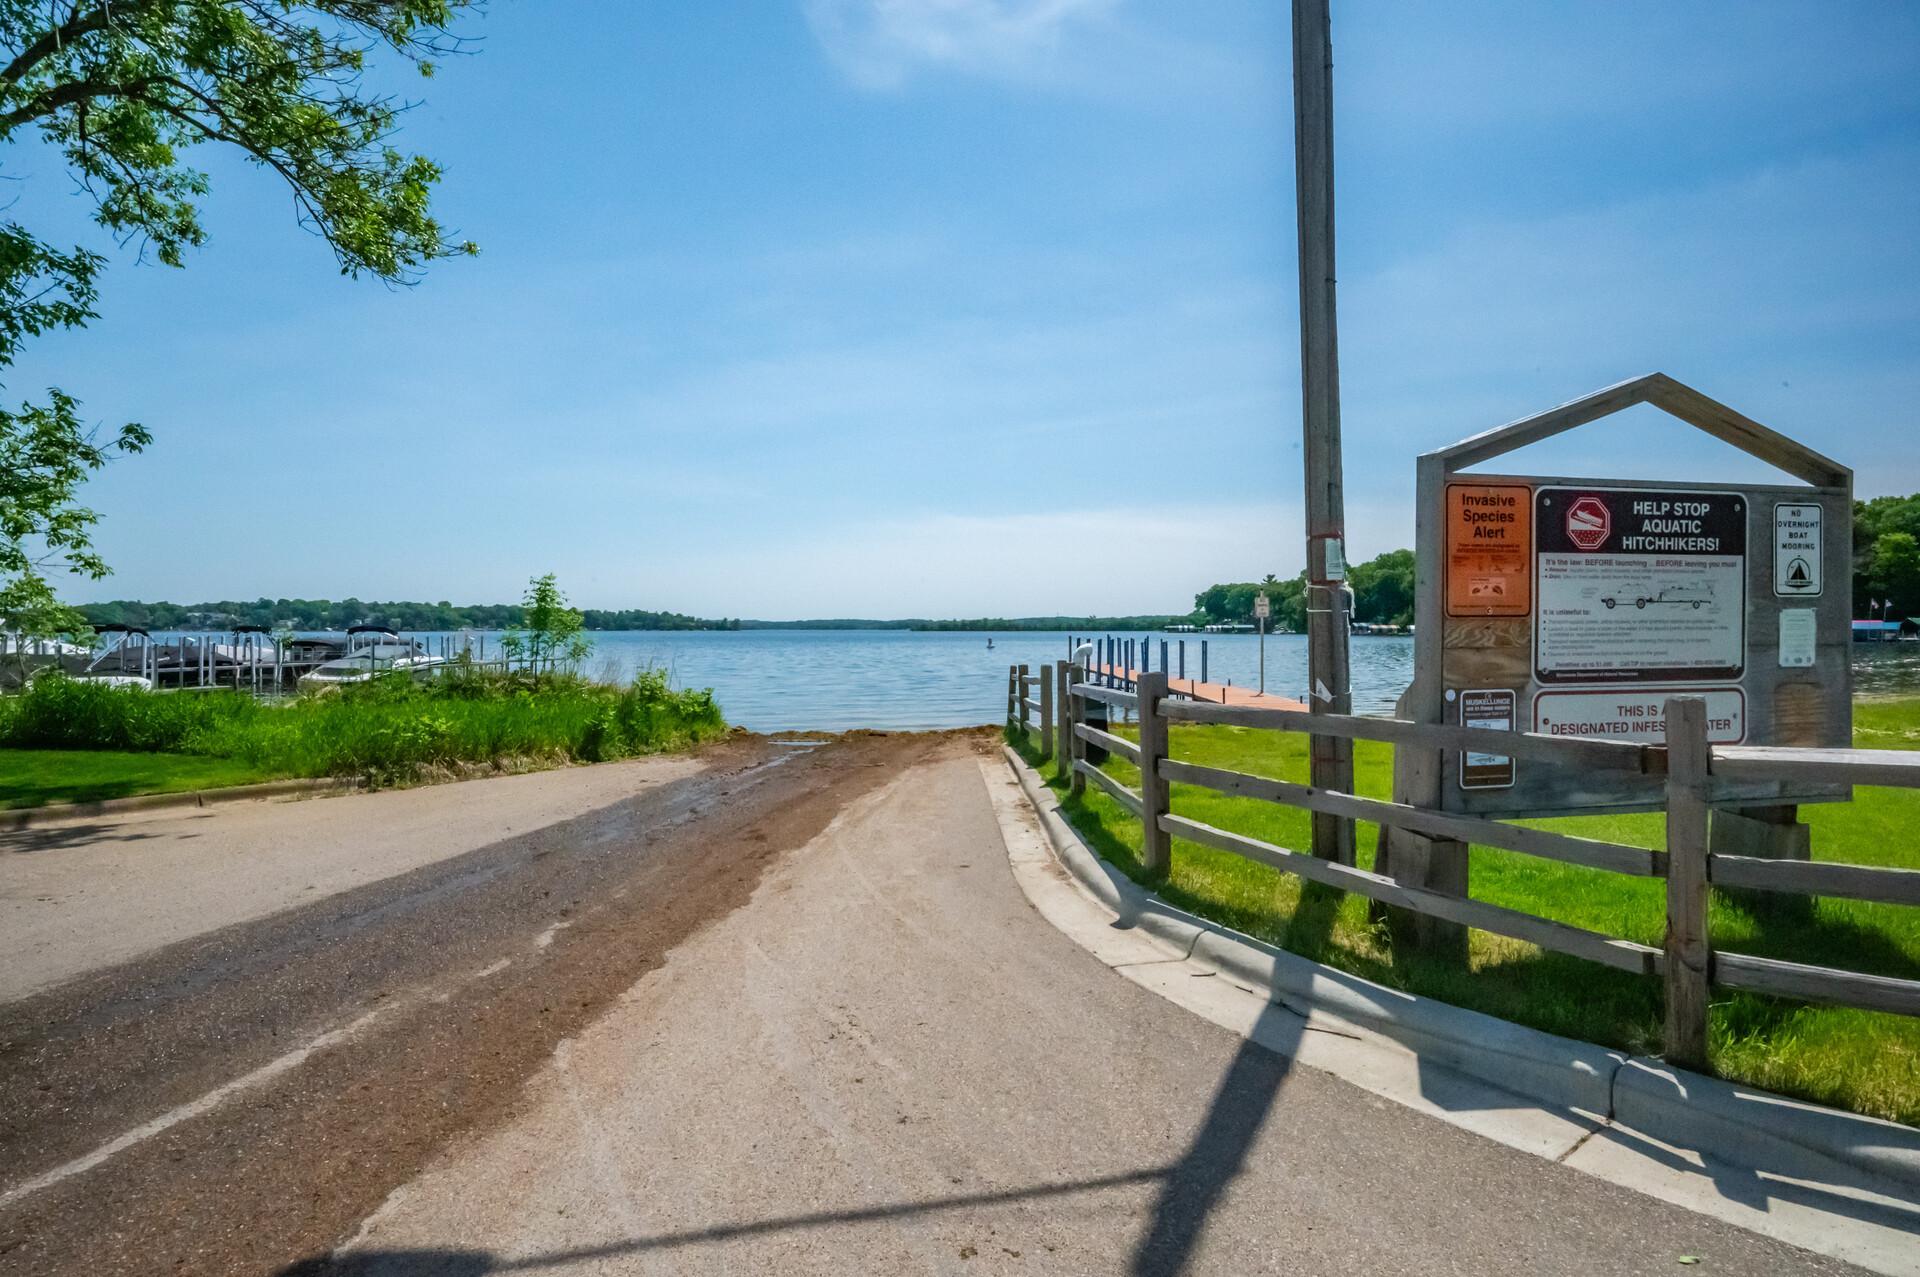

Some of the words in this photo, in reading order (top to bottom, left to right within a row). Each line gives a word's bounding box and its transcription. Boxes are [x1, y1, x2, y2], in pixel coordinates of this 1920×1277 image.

[1462, 493, 1515, 507] Invasive
[1633, 501, 1670, 515] HELP
[1673, 502, 1710, 516] STOP
[1463, 509, 1515, 524] Species
[1473, 526, 1505, 539] Alert
[1642, 519, 1702, 534] AQUATIC
[1622, 536, 1720, 551] HITCHHIKERS!
[1585, 558, 1614, 566] BEFORE
[1655, 559, 1682, 567] BEFORE
[1465, 698, 1511, 706] MUSKELLUNGE
[1616, 705, 1644, 717] THIS
[1647, 705, 1658, 716] IS
[1551, 721, 1629, 735] DESIGNATED
[1632, 721, 1666, 733] INFES
